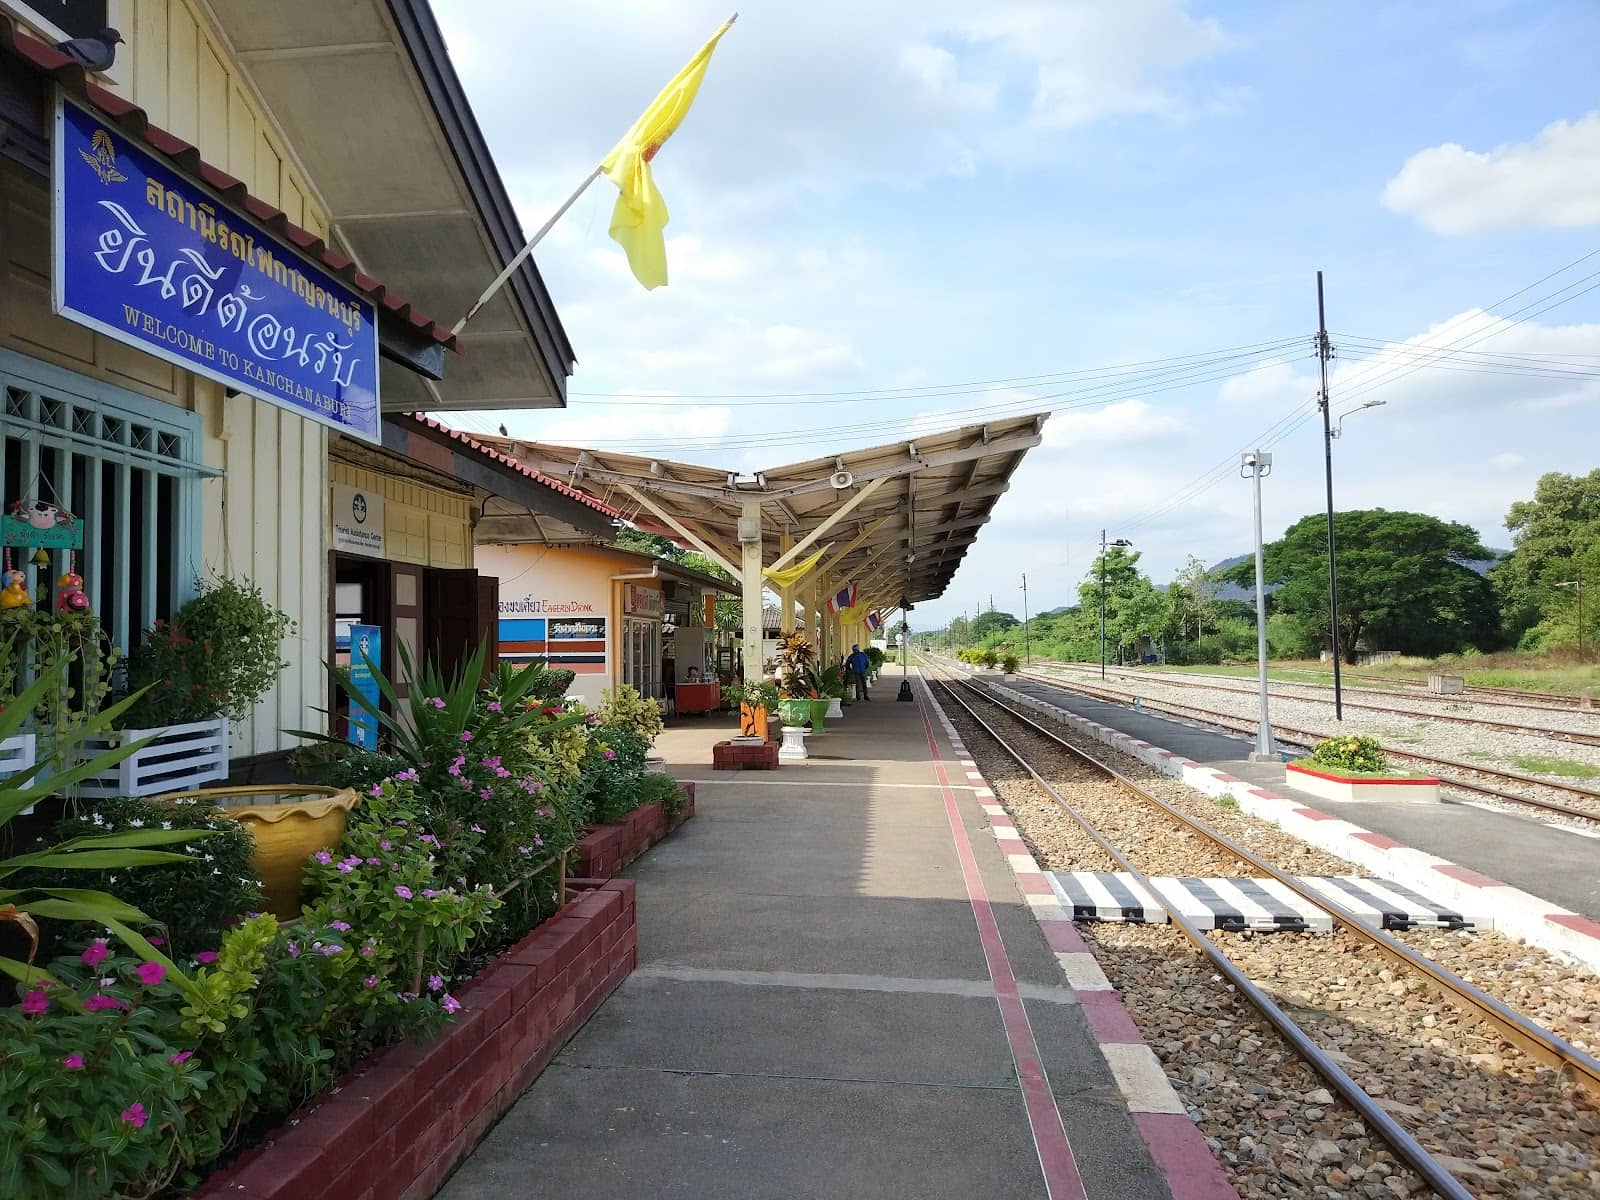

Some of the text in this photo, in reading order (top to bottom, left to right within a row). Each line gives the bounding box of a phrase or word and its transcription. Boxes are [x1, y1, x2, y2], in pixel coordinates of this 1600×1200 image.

[94, 200, 361, 388] ยินดีต้อนรับ
[122, 303, 215, 361] WELCOME
[219, 350, 240, 370] TO
[145, 177, 361, 337] สถานีรถไฟกาญจนบุรี
